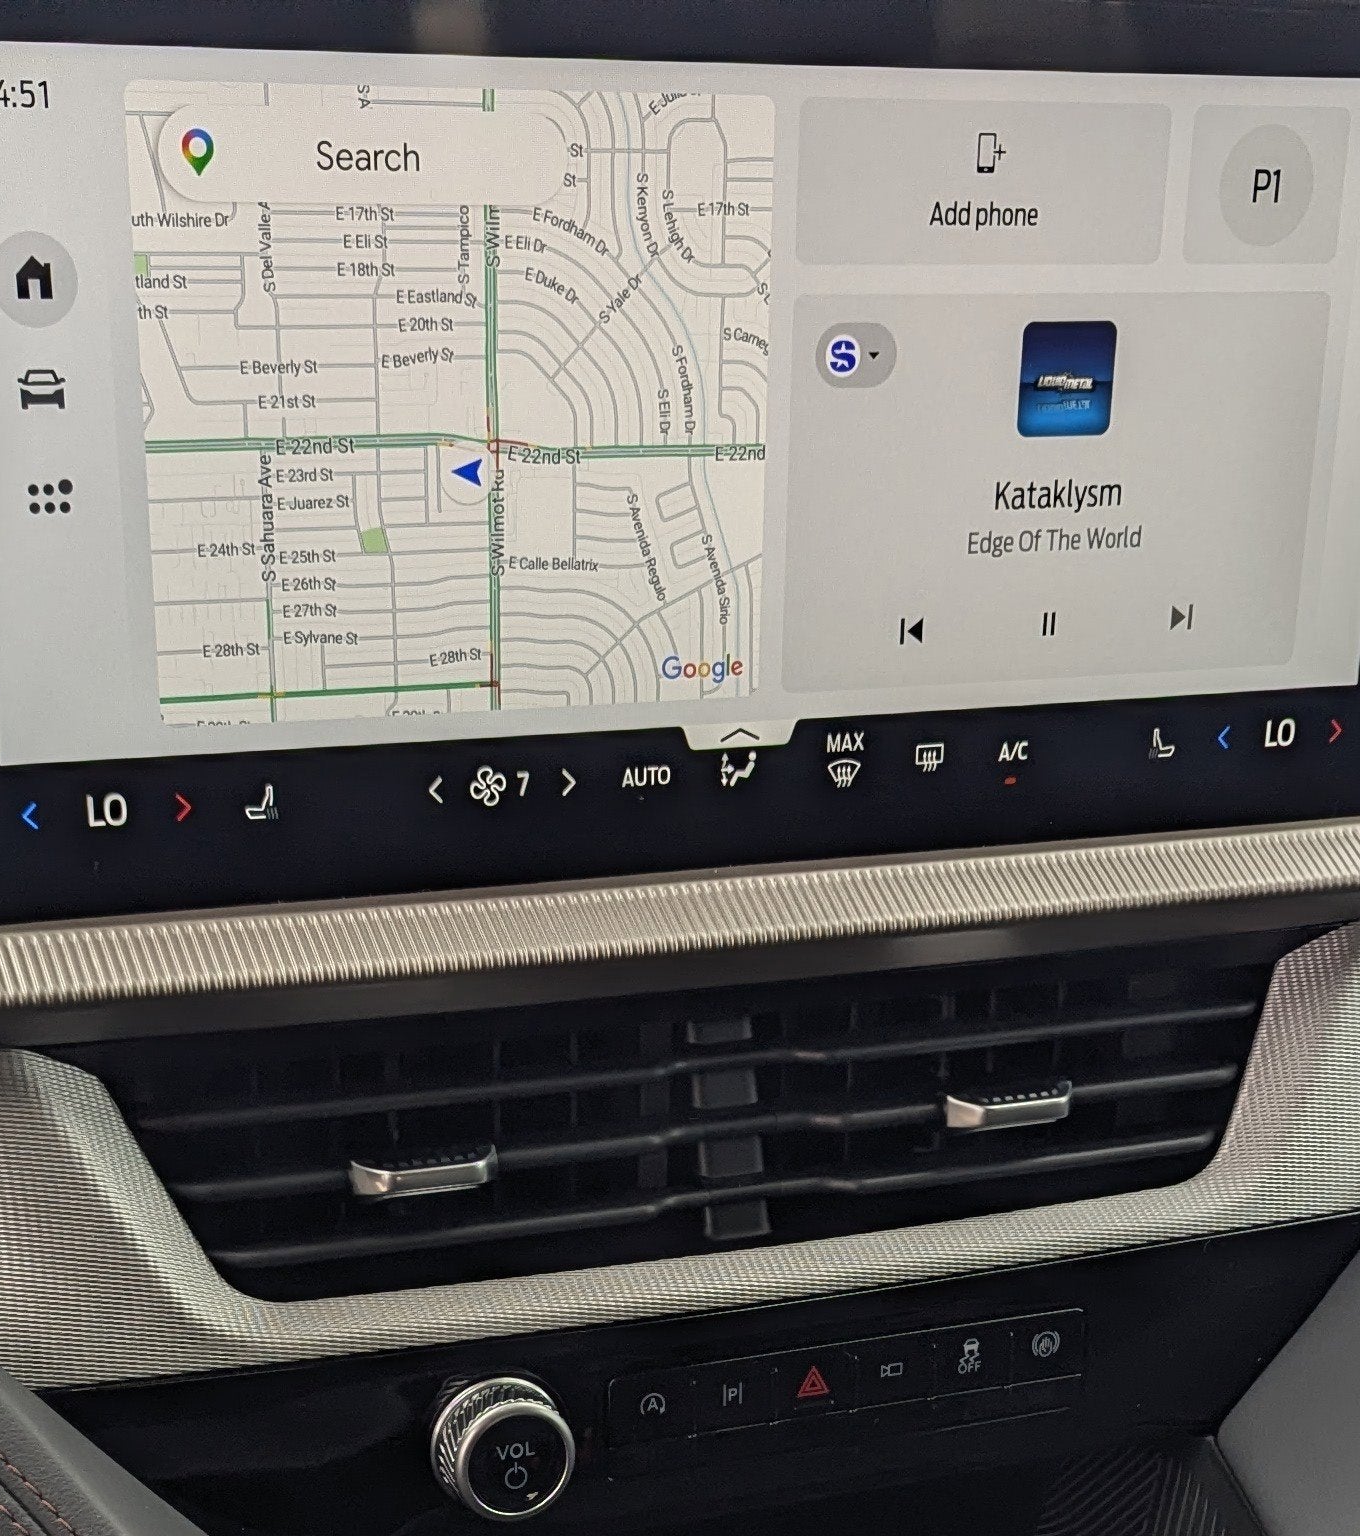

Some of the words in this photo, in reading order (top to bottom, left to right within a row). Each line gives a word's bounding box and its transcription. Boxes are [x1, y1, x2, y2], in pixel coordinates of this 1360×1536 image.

[316, 140, 420, 172] Search
[570, 143, 584, 158] St
[564, 173, 577, 188] St
[1252, 168, 1282, 203] P1
[335, 207, 344, 221] E
[349, 206, 378, 221] 17th
[380, 207, 394, 222] St
[697, 202, 706, 216] E
[709, 202, 735, 217] 17th
[737, 202, 750, 217] St
[930, 200, 971, 226] Add
[975, 200, 1038, 231] phone
[157, 214, 213, 228] Wilshire
[215, 214, 229, 228] Dr
[636, 187, 652, 241] Kenyon
[647, 242, 659, 257] Dr
[258, 212, 271, 252] Valle
[343, 234, 352, 249] E
[355, 234, 371, 249] Eli
[374, 235, 388, 249] St
[458, 205, 473, 270] Tampico
[543, 209, 593, 246] Fordham
[595, 239, 611, 256] Dr
[663, 203, 684, 250] Lehigh
[681, 247, 695, 264] Dr
[505, 235, 513, 249] E
[516, 236, 530, 251] Eli
[533, 239, 548, 255] Dr
[259, 255, 274, 279] Del
[337, 262, 346, 277] E
[349, 262, 378, 277] 18th
[381, 262, 395, 277] St
[135, 274, 170, 289] tland
[173, 274, 187, 289] St
[535, 269, 565, 295] Duke
[564, 288, 580, 304] Dr
[396, 289, 405, 304] E
[407, 289, 463, 305] Eastland
[464, 293, 477, 309] St
[607, 289, 632, 315] Yale
[627, 274, 643, 291] Dr
[154, 305, 169, 320] St
[398, 318, 407, 333] E
[410, 318, 438, 333] 20th
[440, 317, 454, 332] St
[393, 348, 439, 369] Beverly
[441, 346, 455, 363] St
[240, 360, 249, 375] E
[252, 360, 301, 378] Beverly
[303, 359, 318, 374] St
[258, 395, 267, 409] E
[271, 394, 299, 410] 21st
[302, 394, 316, 409] St
[676, 356, 694, 418] Fordham
[685, 421, 695, 435] Dr
[659, 401, 670, 418] Eli
[660, 421, 670, 435] Dr
[275, 439, 286, 455] E
[290, 438, 333, 455] 22nd
[337, 437, 355, 454] St
[507, 445, 518, 461] E
[521, 448, 561, 464] 22nd
[565, 449, 581, 464] St
[715, 446, 726, 461] E
[729, 445, 766, 461] 22nd
[258, 454, 272, 488] Ave
[276, 468, 285, 483] E
[288, 468, 317, 483] 23rd
[319, 468, 334, 482] St
[277, 496, 286, 511] E
[290, 496, 333, 511] Juarez
[336, 494, 350, 510] St
[995, 479, 1122, 513] Kataklysm
[259, 493, 276, 566] Sahuara
[491, 497, 505, 560] Wilmot
[197, 543, 206, 557] E
[209, 542, 240, 558] 24th
[241, 541, 256, 556] St
[968, 530, 1015, 558] Edge
[1019, 529, 1042, 552] Of
[1046, 528, 1081, 551] The
[1087, 525, 1142, 550] World
[292, 548, 320, 565] 25th
[322, 548, 336, 564] St
[519, 556, 549, 571] Calle
[552, 557, 599, 572] Bellatrix
[629, 507, 651, 557] Avenida
[645, 557, 666, 601] Regulo
[293, 577, 322, 592] 26th
[324, 577, 337, 591] St
[704, 547, 727, 595] Avenida
[719, 596, 730, 625] Sirio
[295, 604, 322, 619] 27th
[324, 603, 338, 618] St
[295, 631, 343, 646] Sylvane
[345, 631, 358, 646] St
[214, 643, 243, 658] 28th
[246, 643, 260, 657] St
[440, 649, 467, 665] 28th
[470, 648, 481, 661] St
[662, 654, 743, 684] Google
[826, 731, 865, 754] MAX
[1264, 717, 1296, 748] LO
[998, 740, 1029, 762] A/C
[516, 771, 529, 798] 7
[621, 766, 671, 789] AUTO
[86, 792, 128, 827] LO
[957, 1361, 982, 1374] OFF
[496, 1442, 537, 1462] VOL
